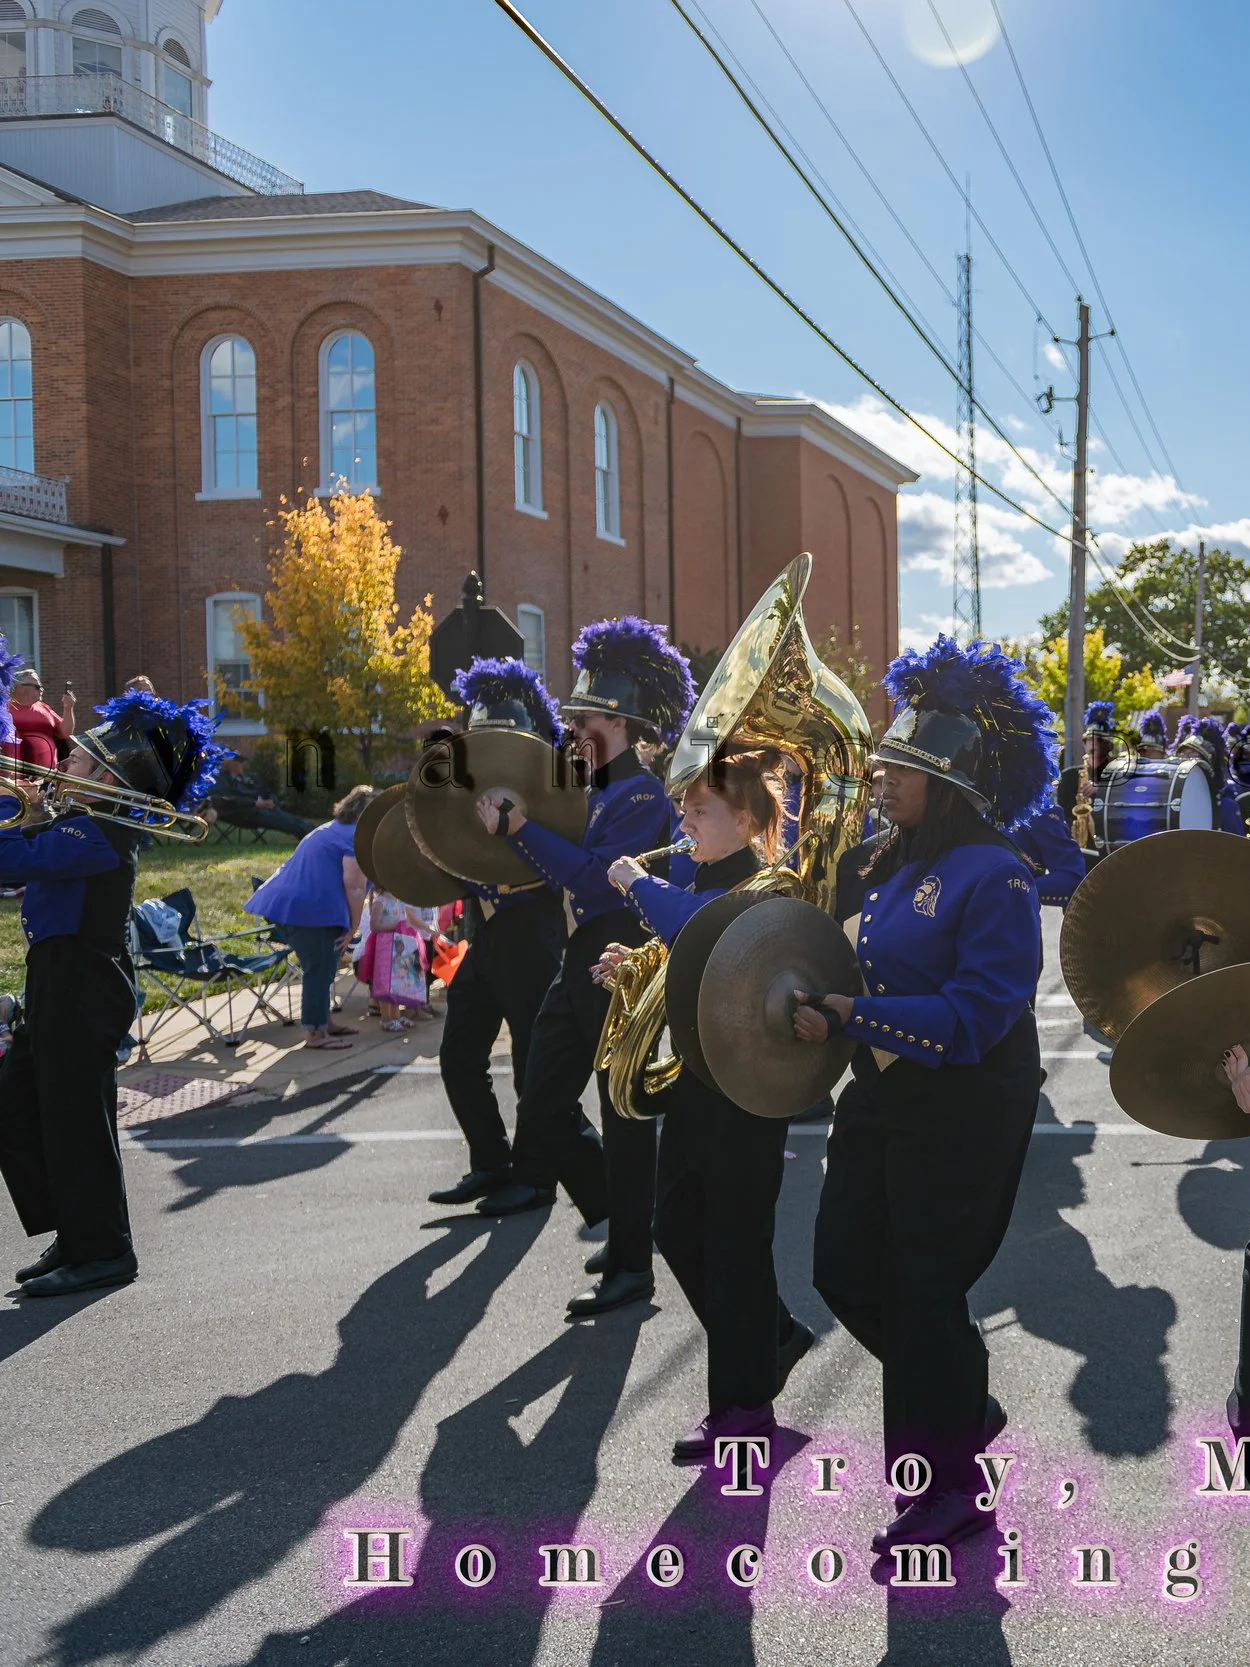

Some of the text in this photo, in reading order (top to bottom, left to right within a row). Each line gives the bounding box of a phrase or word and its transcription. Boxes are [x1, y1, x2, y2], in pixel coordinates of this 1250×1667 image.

[629, 793, 655, 803] TROY
[60, 827, 87, 840] TROY
[1007, 878, 1031, 894] TROY
